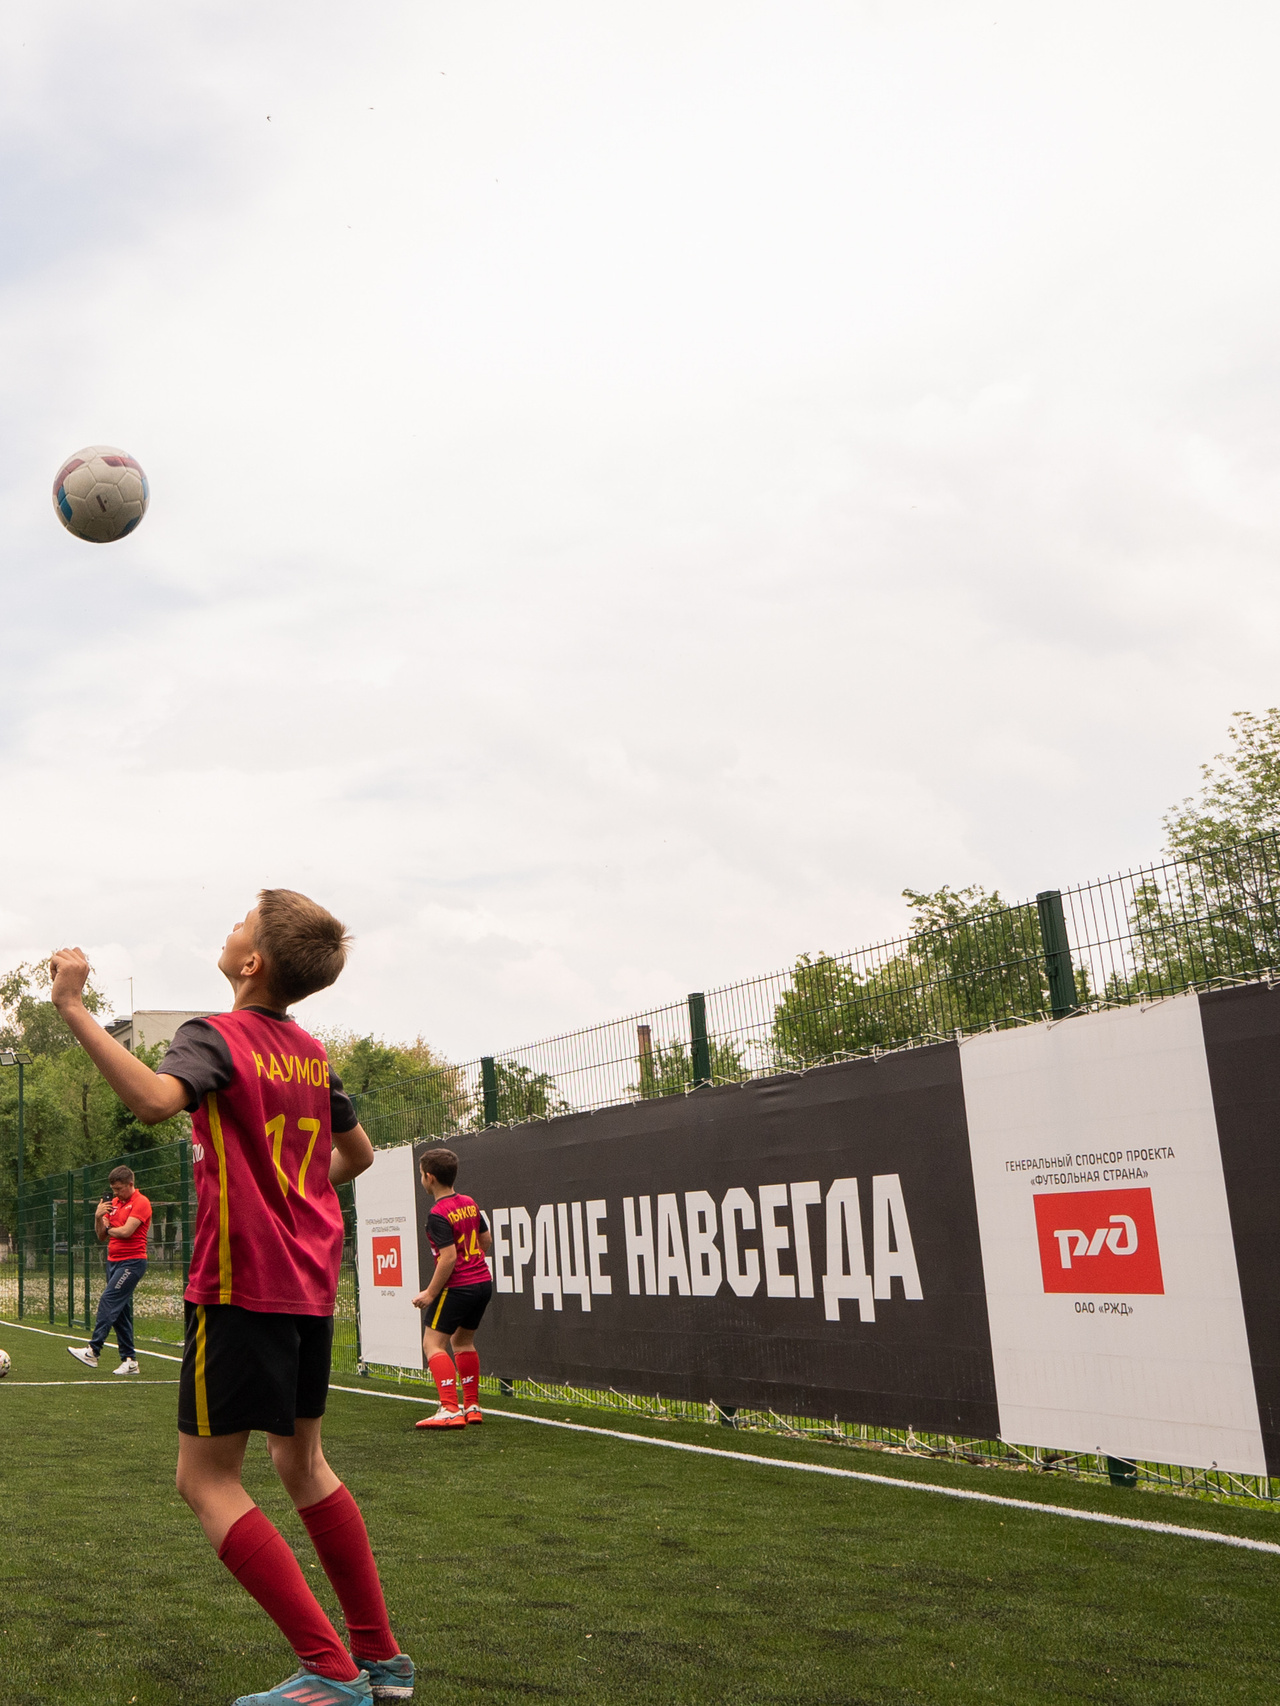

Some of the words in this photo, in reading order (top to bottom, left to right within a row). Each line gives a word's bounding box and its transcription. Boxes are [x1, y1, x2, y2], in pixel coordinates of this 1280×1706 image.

[251, 1051, 330, 1088] НАУМОВ
[265, 1113, 321, 1199] 17
[1005, 1153, 1073, 1172] ГЕНЕРАЛЬНЫЙ
[1075, 1151, 1123, 1166] СПОНСОР
[1126, 1146, 1176, 1162] ПРОЕКТА
[1030, 1170, 1100, 1186] «ФУТБОЛЬНАЯ
[1103, 1167, 1149, 1182] СТРАНА»
[480, 1199, 612, 1312] ЕРДЦЕ
[623, 1174, 924, 1322] НАВСЕГДА
[1074, 1302, 1095, 1314] ОАО
[1098, 1303, 1134, 1316] «РЖД»
